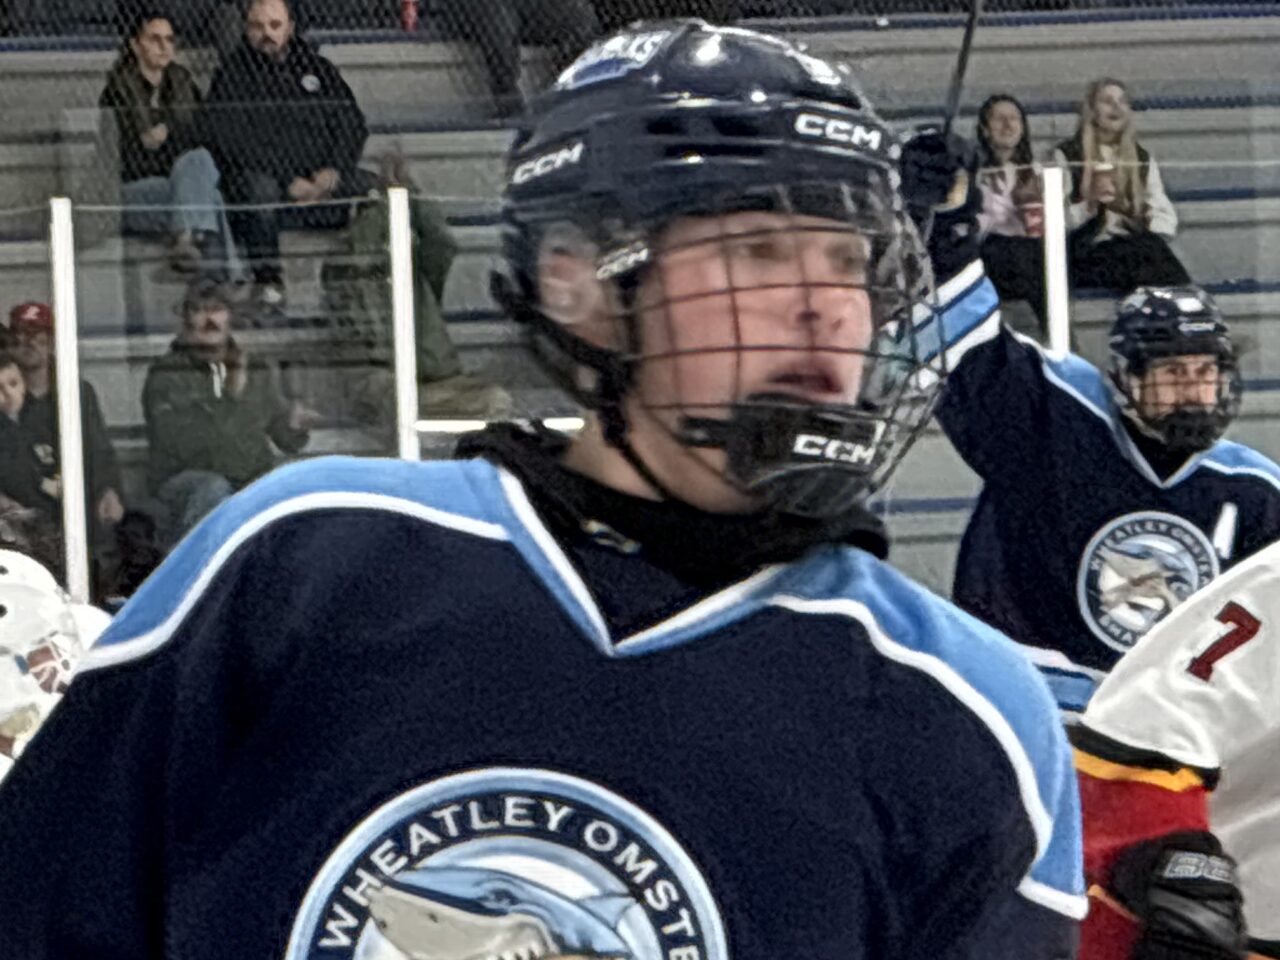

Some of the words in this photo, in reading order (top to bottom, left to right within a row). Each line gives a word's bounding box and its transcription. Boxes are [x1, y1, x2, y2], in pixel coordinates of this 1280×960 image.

[794, 113, 884, 151] CCM
[512, 141, 584, 185] CCM
[793, 433, 877, 466] CCM
[1186, 600, 1261, 681] 7
[319, 797, 570, 950] WHEATLEY
